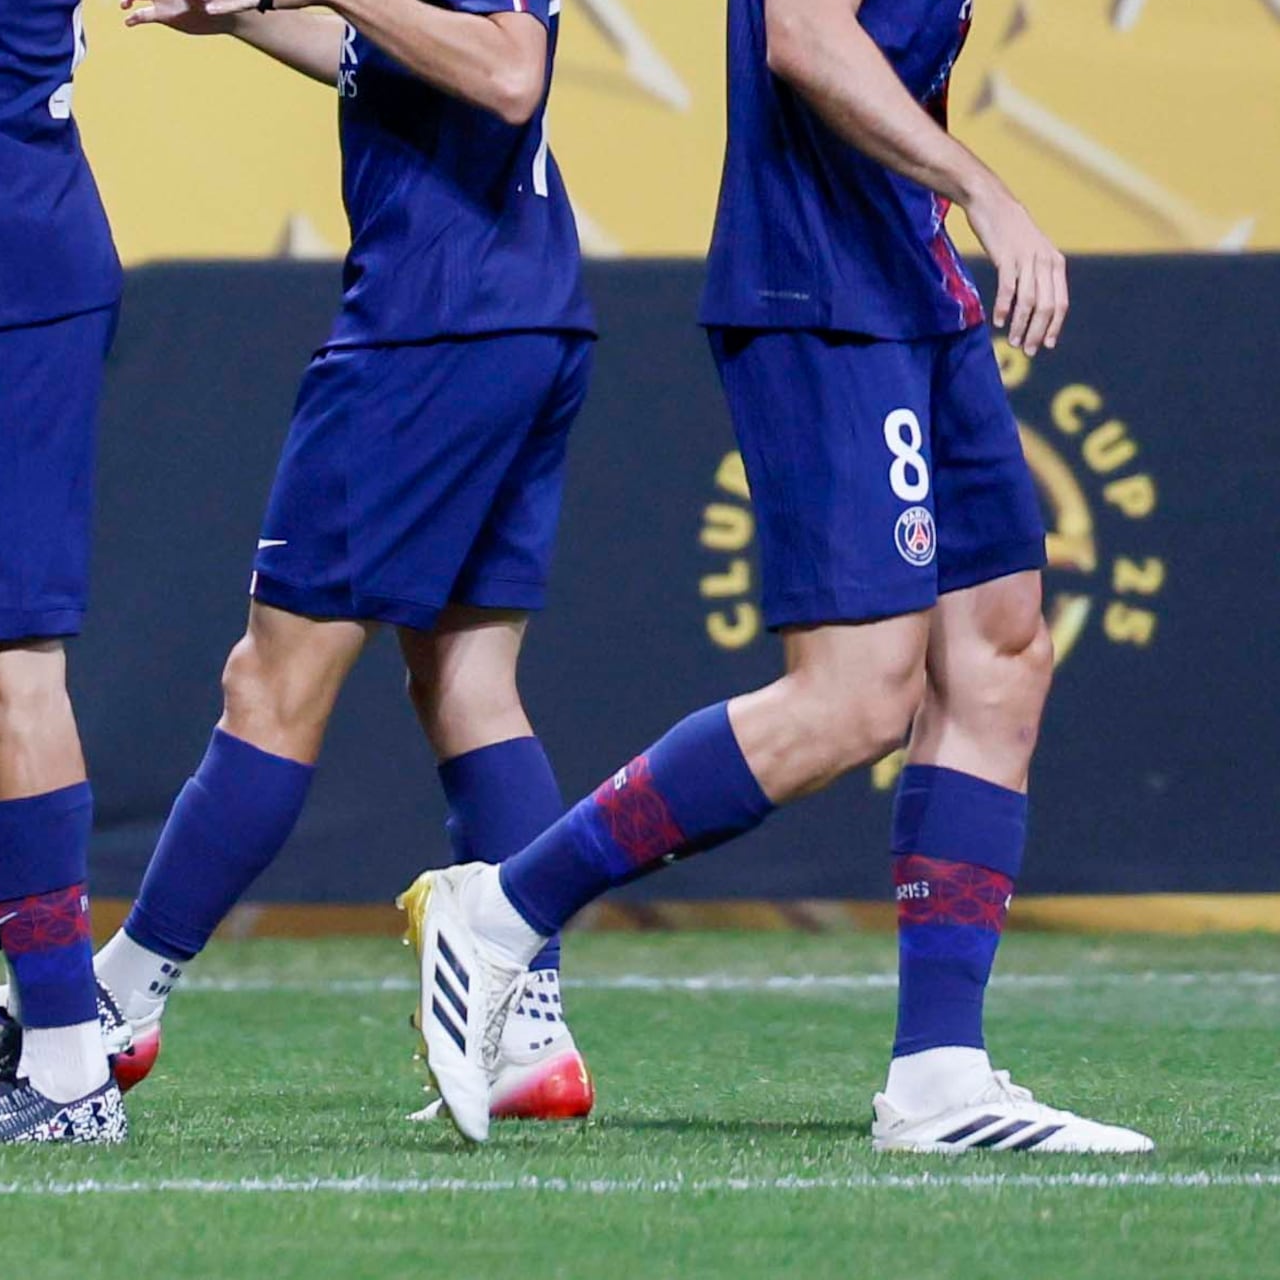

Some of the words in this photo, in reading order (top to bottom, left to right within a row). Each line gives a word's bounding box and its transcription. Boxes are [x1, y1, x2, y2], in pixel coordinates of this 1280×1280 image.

[883, 407, 929, 502] 8
[1051, 383, 1156, 518] CUP
[1104, 557, 1165, 646] 25
